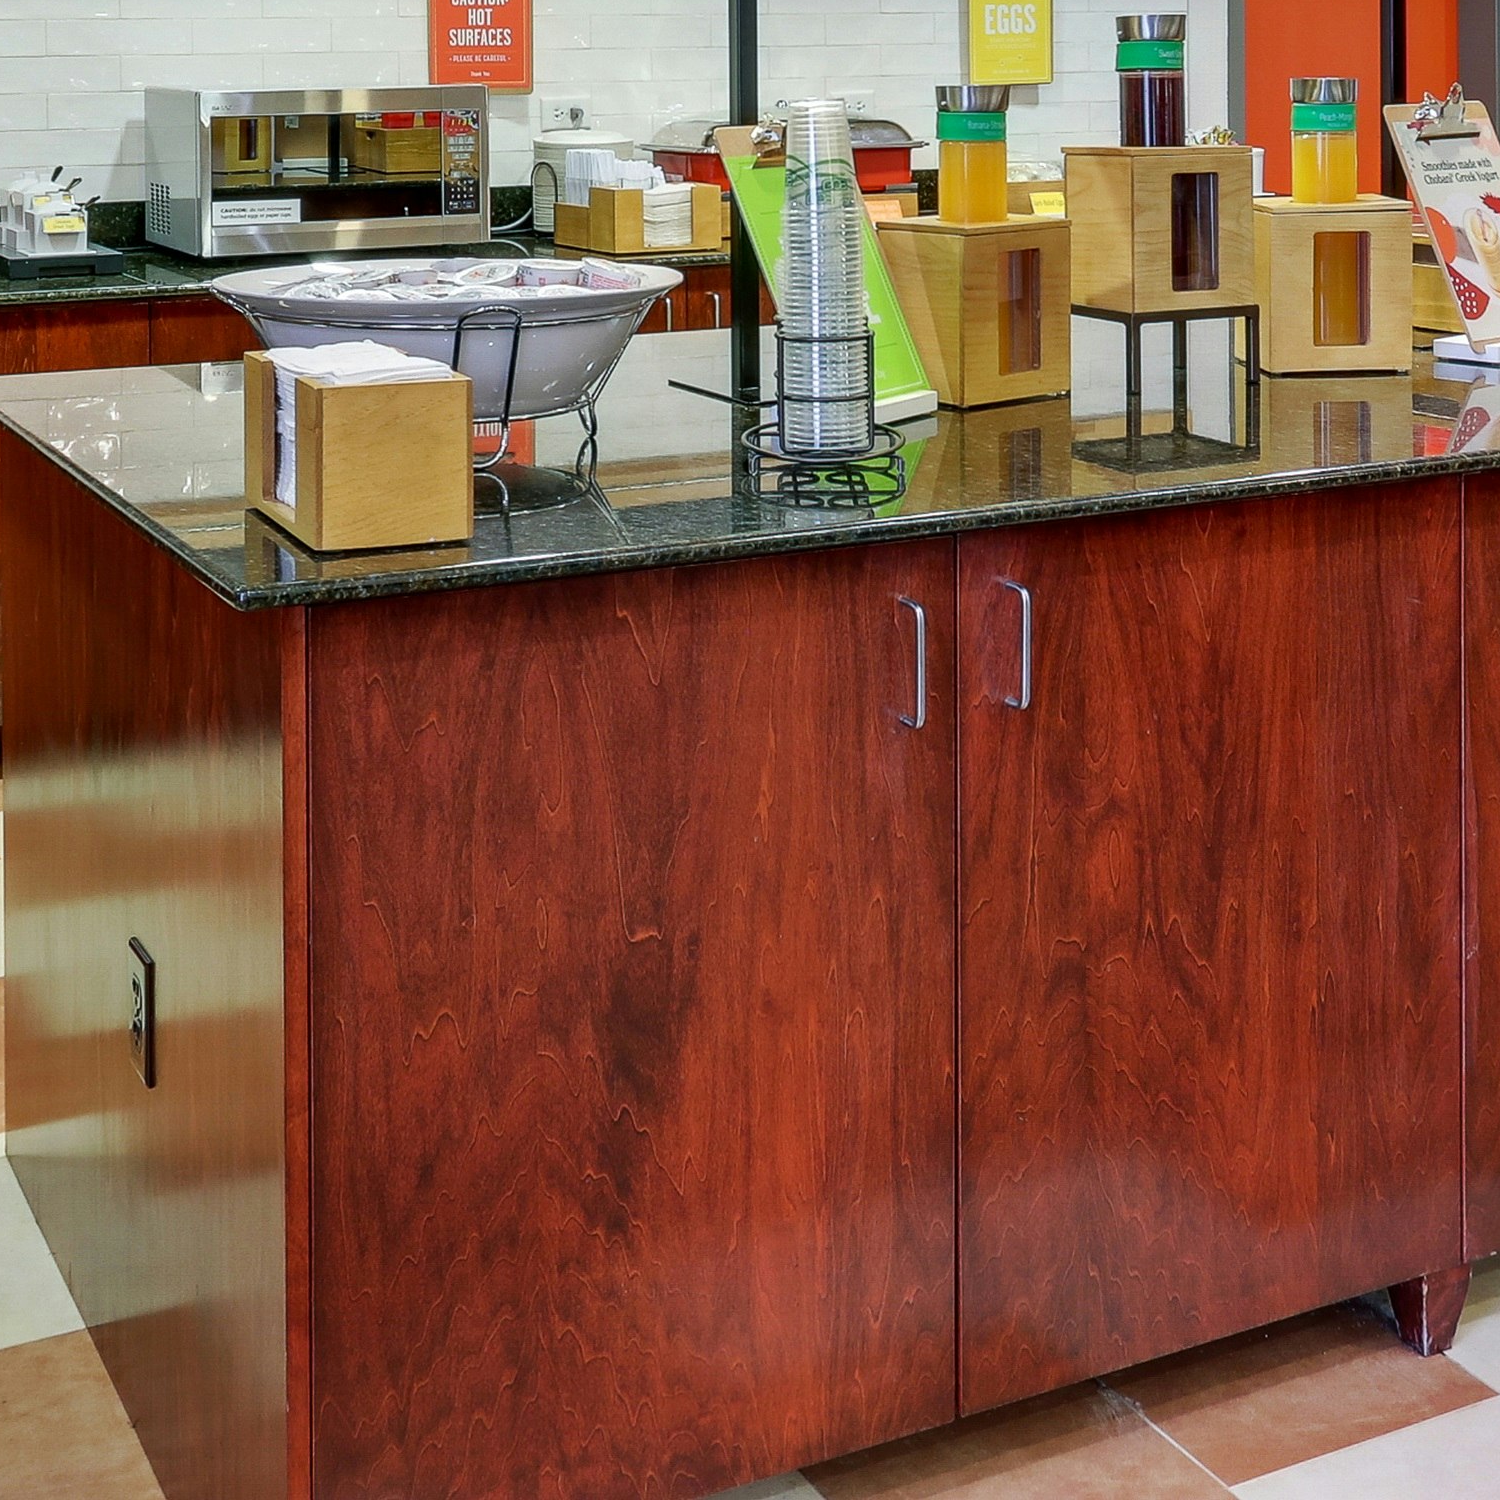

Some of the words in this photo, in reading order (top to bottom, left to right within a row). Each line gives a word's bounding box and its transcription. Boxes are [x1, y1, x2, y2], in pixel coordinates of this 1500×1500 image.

[467, 8, 493, 26] HOT
[984, 3, 1037, 35] EGGS
[449, 28, 512, 46] SURFACES
[452, 54, 473, 63] PLEASE
[475, 54, 482, 62] BE
[483, 54, 507, 62] CAREFUL
[1421, 160, 1458, 172] Smoothies
[1459, 159, 1477, 169] made
[1477, 158, 1492, 168] with
[1455, 172, 1477, 183] Greek
[1477, 171, 1500, 183] Yogurt
